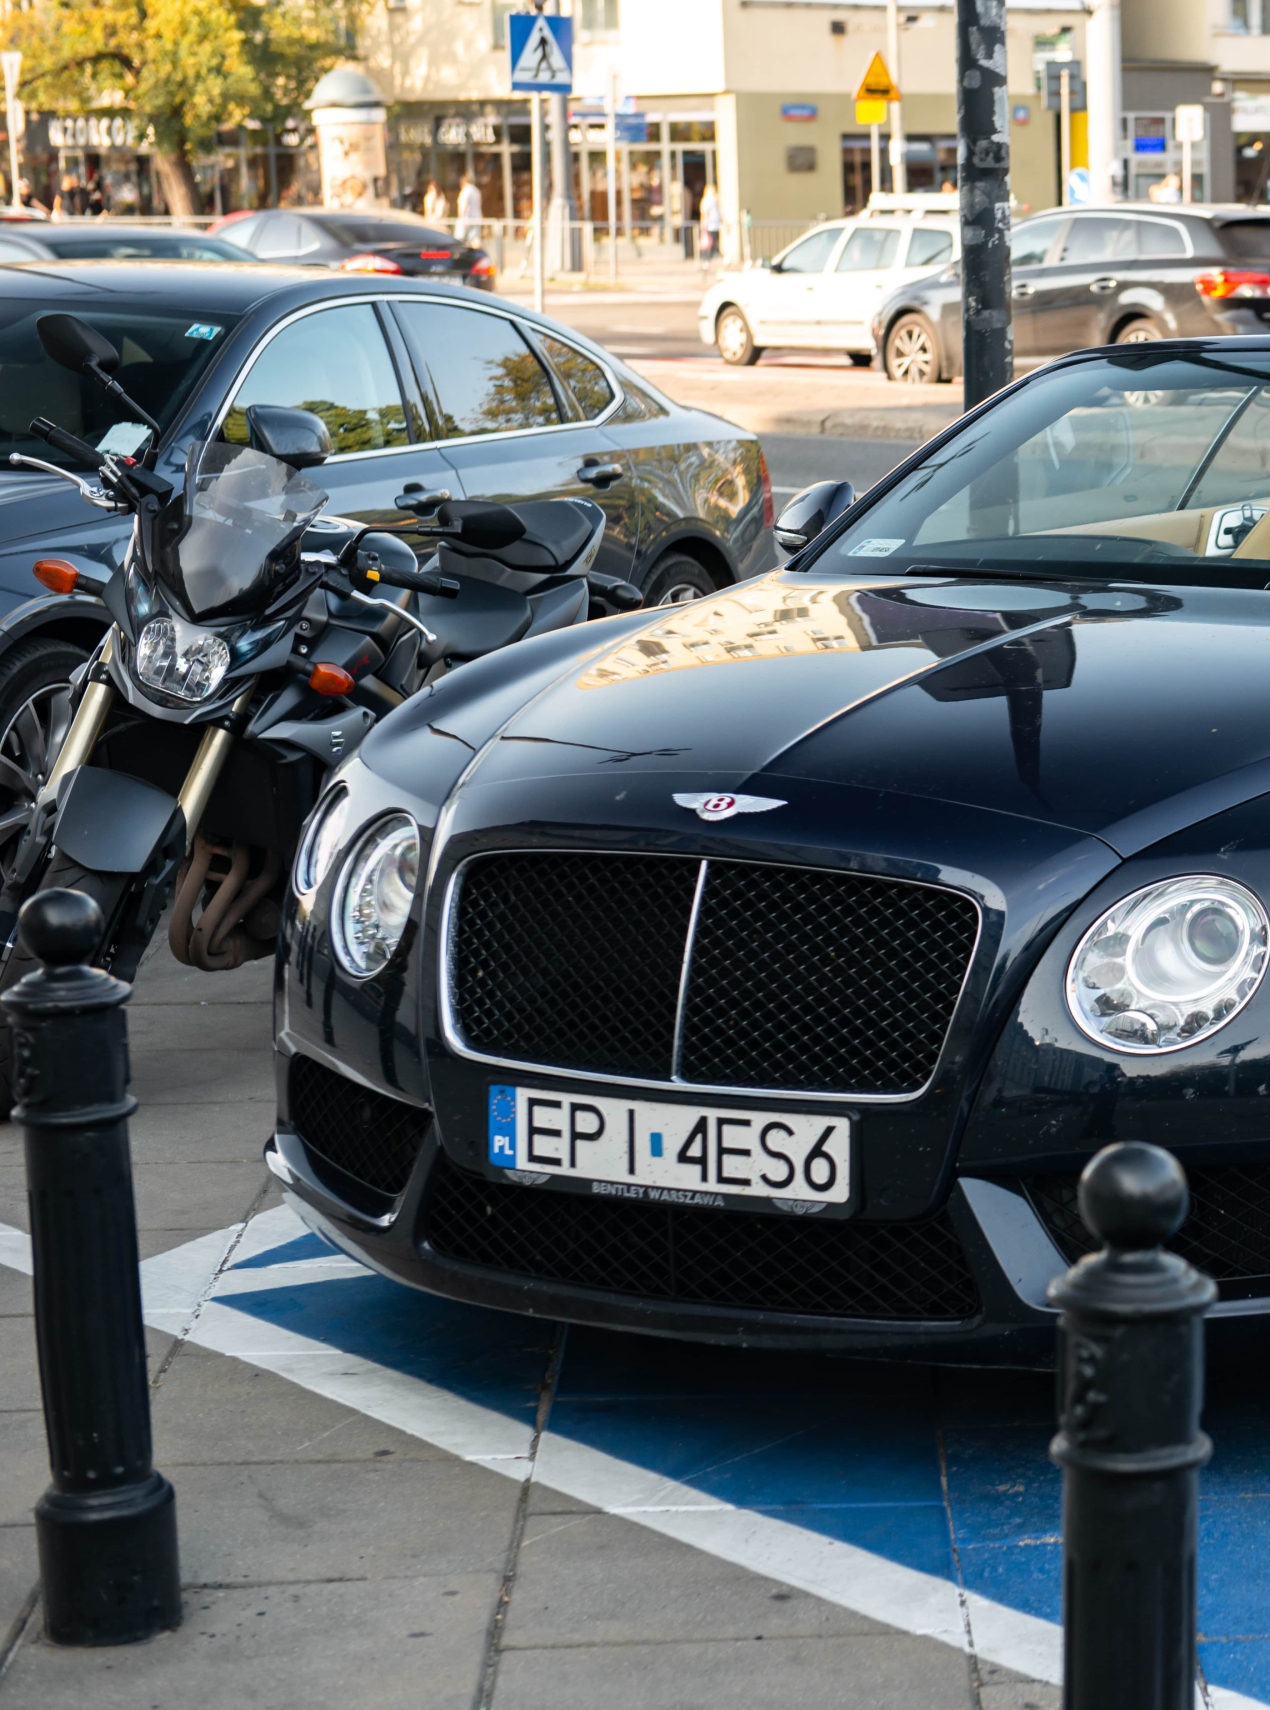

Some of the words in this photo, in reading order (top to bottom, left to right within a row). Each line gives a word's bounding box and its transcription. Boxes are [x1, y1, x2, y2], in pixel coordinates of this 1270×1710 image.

[493, 1135, 515, 1155] PL
[527, 1097, 636, 1176] EPI
[677, 1115, 838, 1193] 4ES6
[591, 1181, 645, 1199] BENTLEY
[648, 1187, 726, 1208] WARSZAWA
